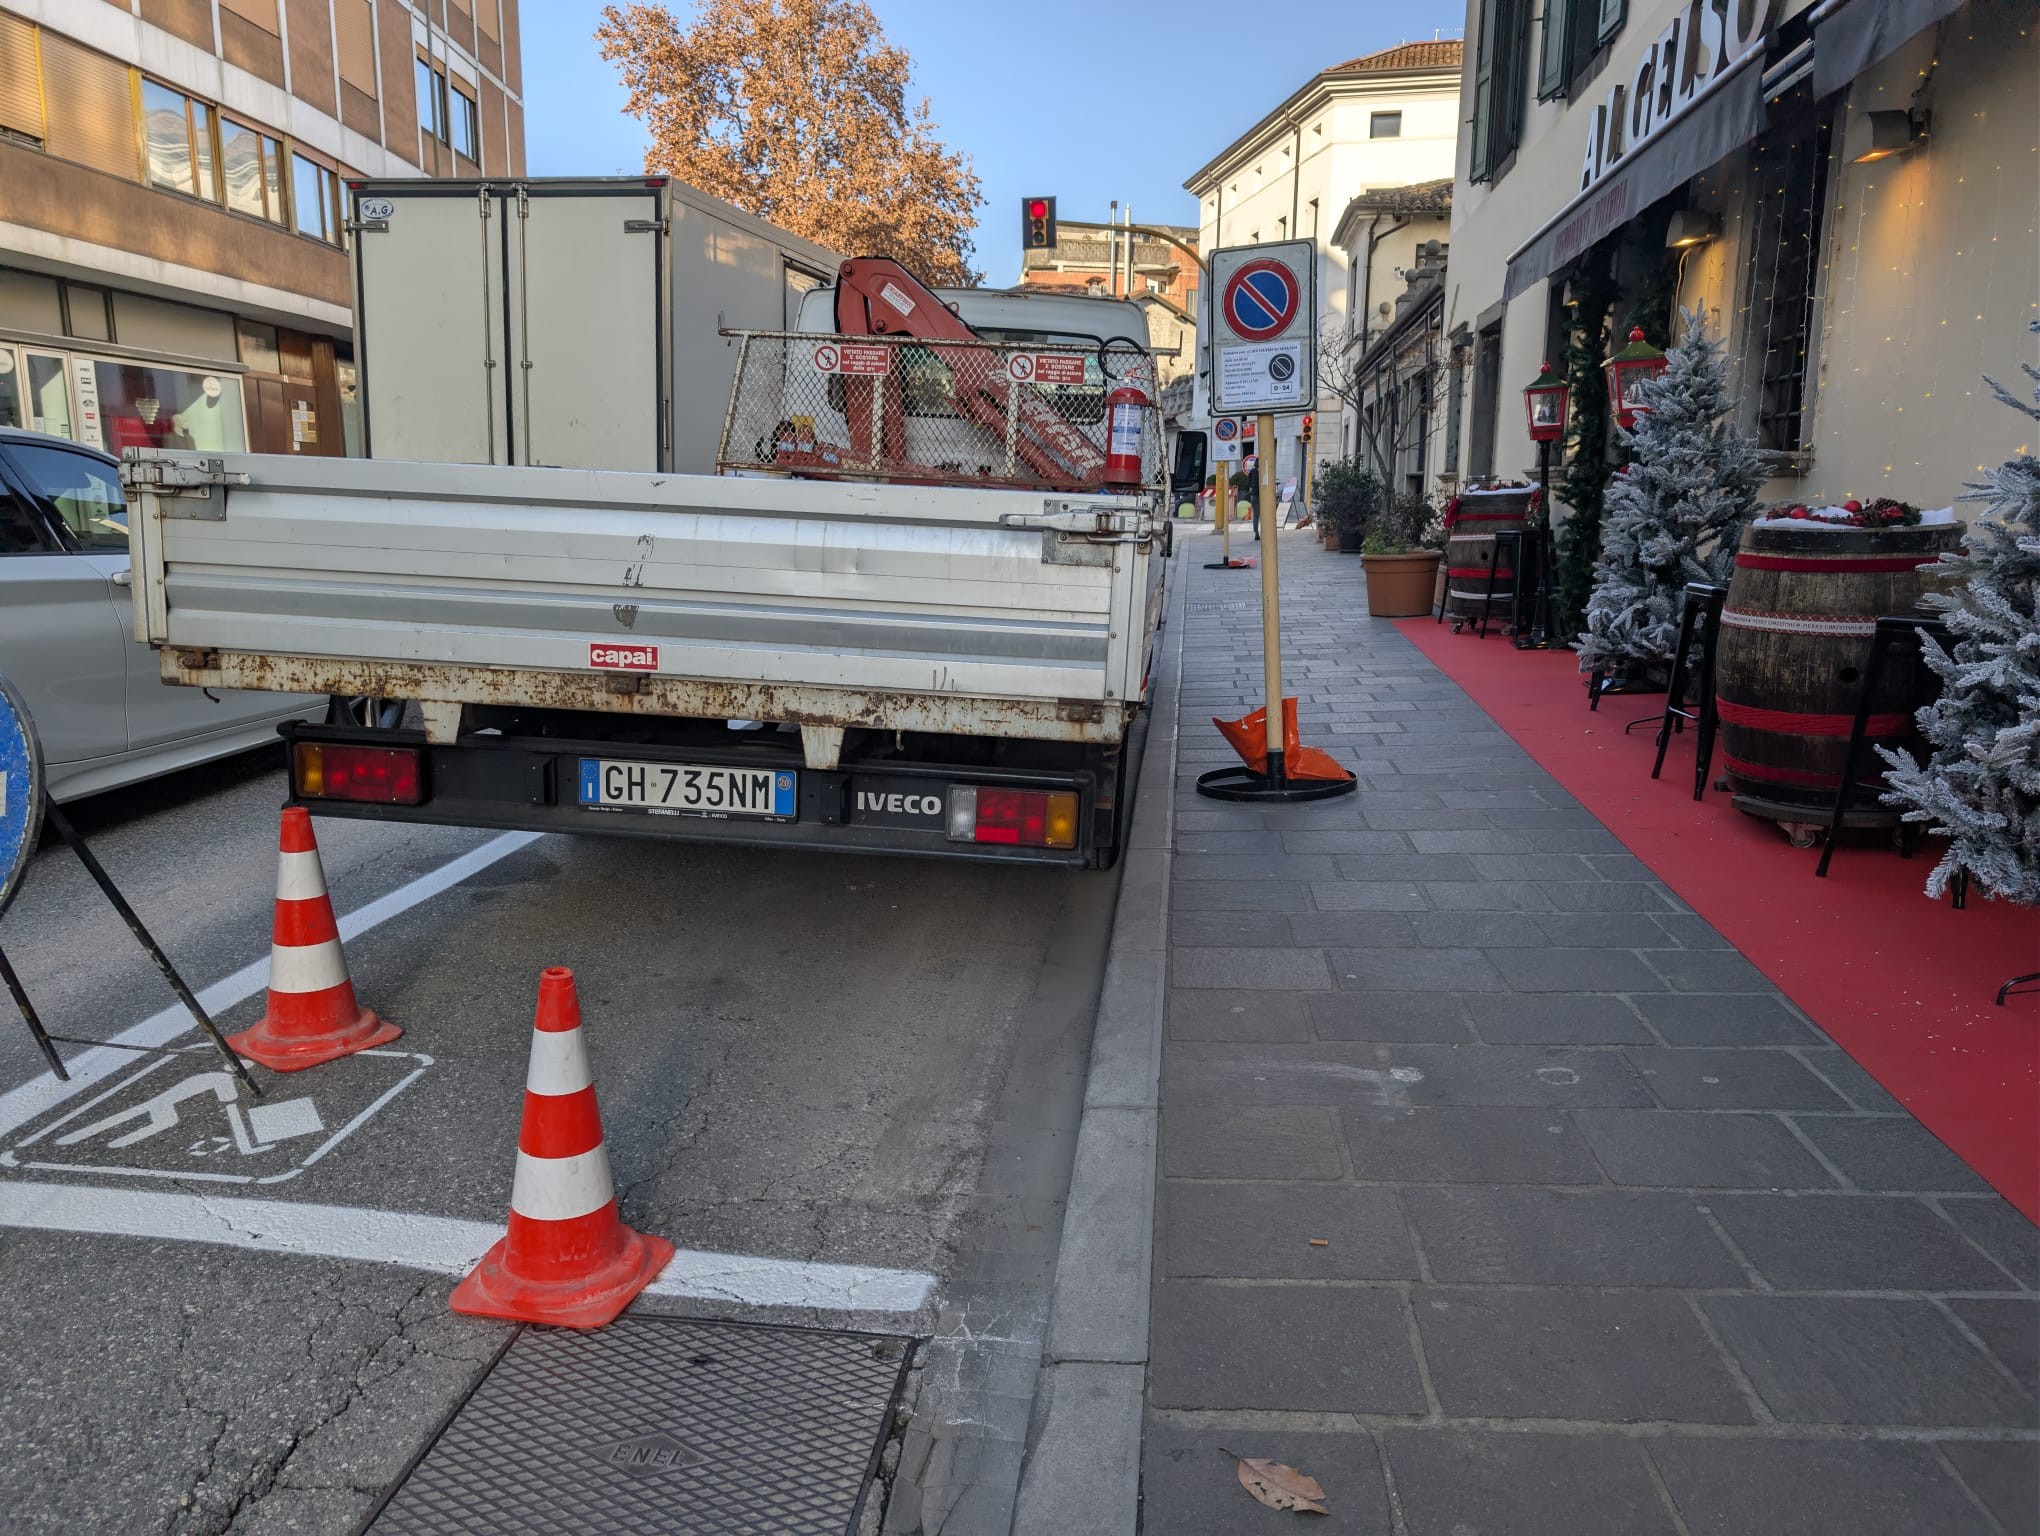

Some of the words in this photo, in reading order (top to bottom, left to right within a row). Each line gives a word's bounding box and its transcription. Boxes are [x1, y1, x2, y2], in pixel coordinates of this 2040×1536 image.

[1579, 85, 1624, 192] AL
[1625, 0, 1776, 152] GELSO
[591, 647, 653, 667] capai
[605, 765, 646, 802] GH
[660, 768, 770, 810] 735NM
[648, 808, 680, 816] STEFANELLI
[857, 791, 942, 815] IVECO
[611, 1444, 683, 1466] ENEL
